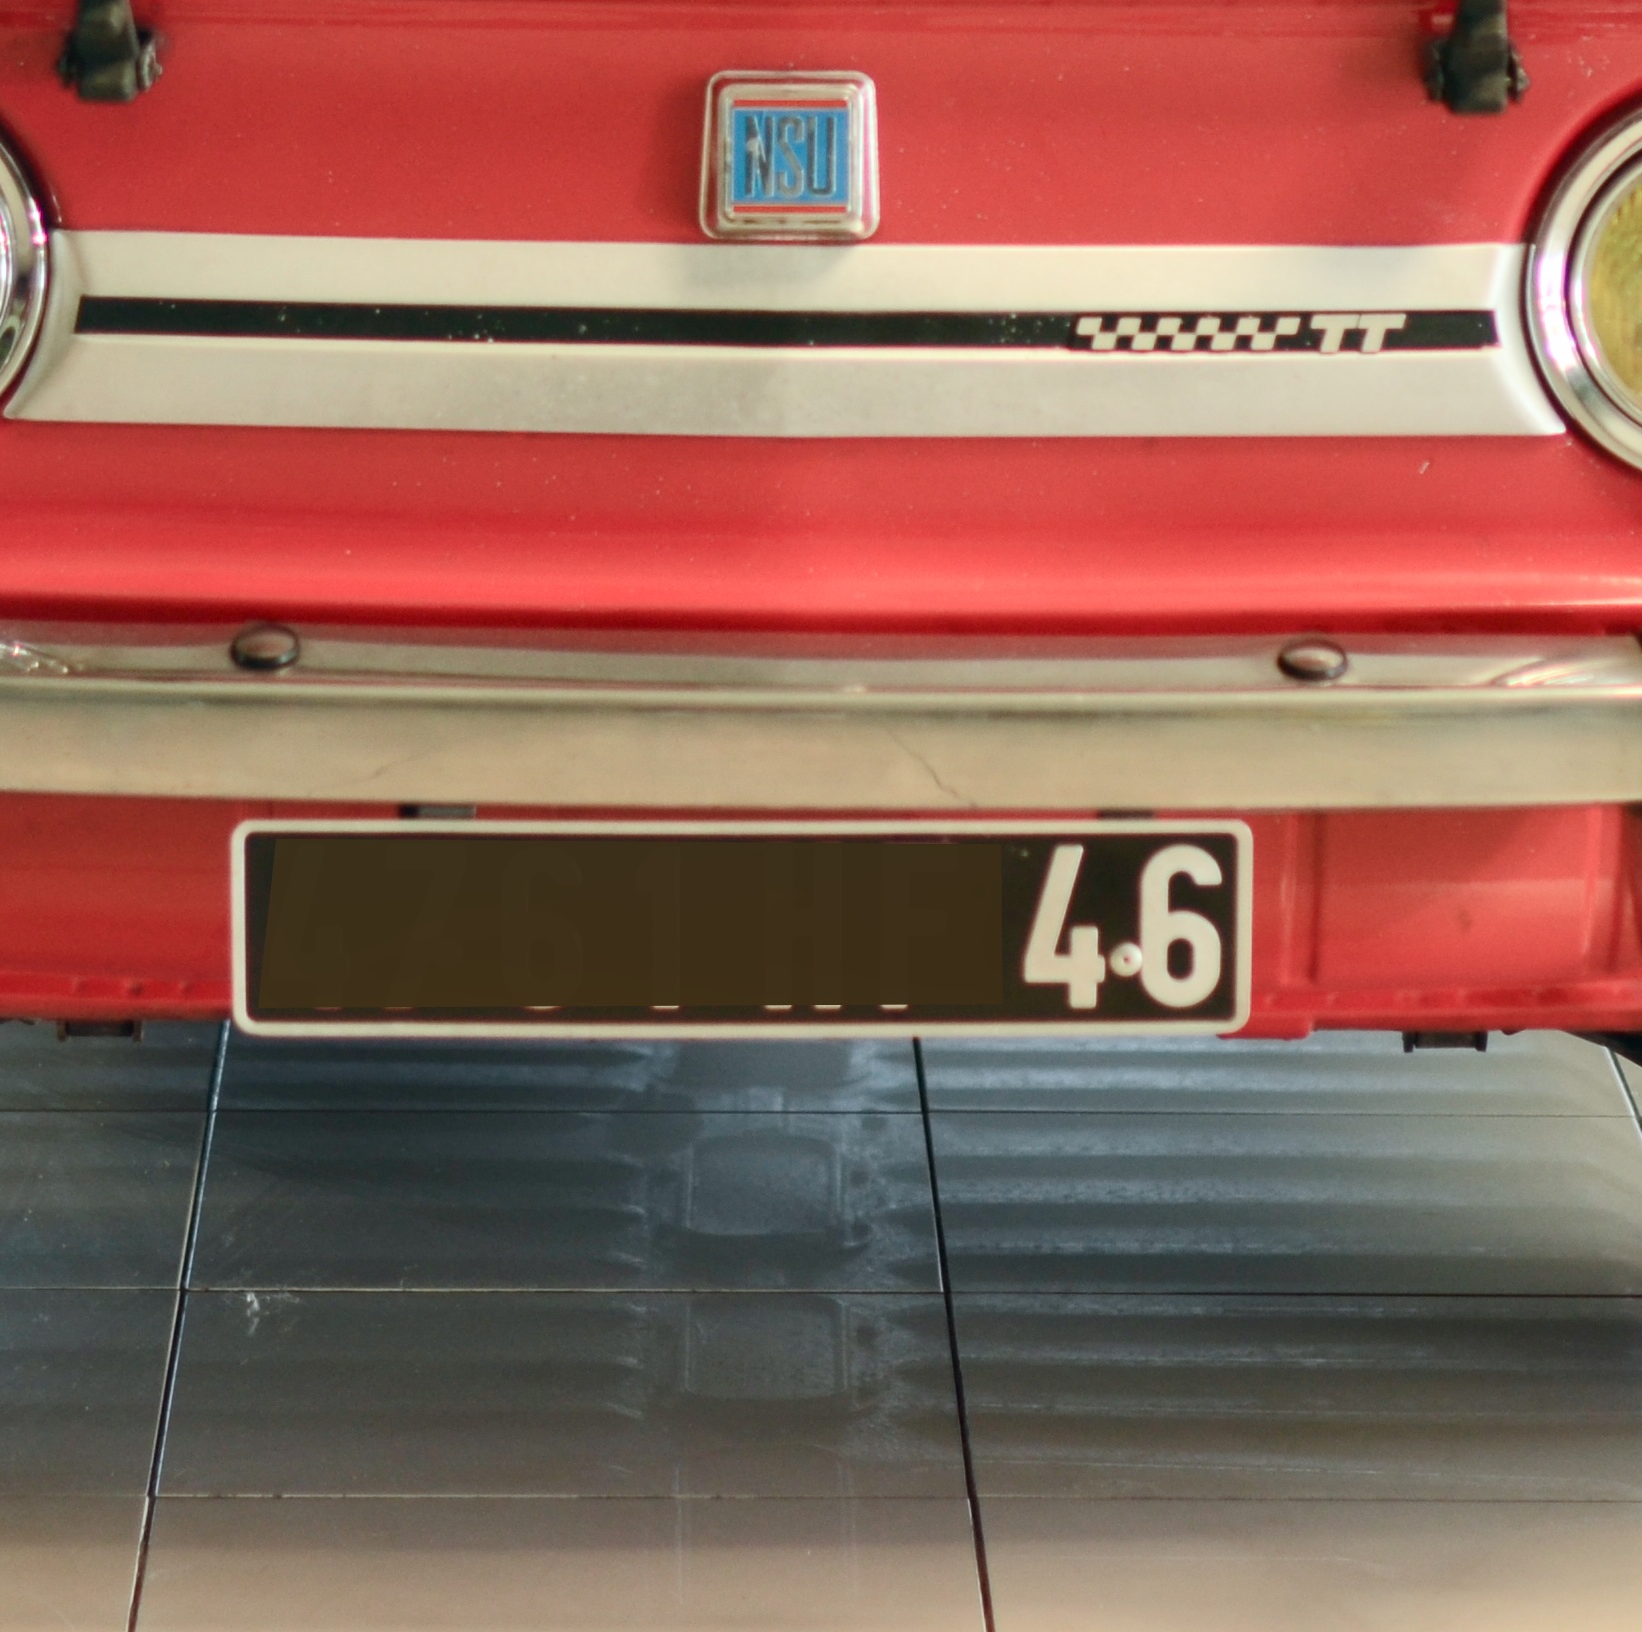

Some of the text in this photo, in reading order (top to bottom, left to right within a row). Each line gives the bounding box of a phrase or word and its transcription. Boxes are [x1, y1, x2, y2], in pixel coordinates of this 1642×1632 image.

[745, 115, 836, 197] NSU
[1310, 313, 1406, 354] TT
[1024, 843, 1223, 1009] 46
